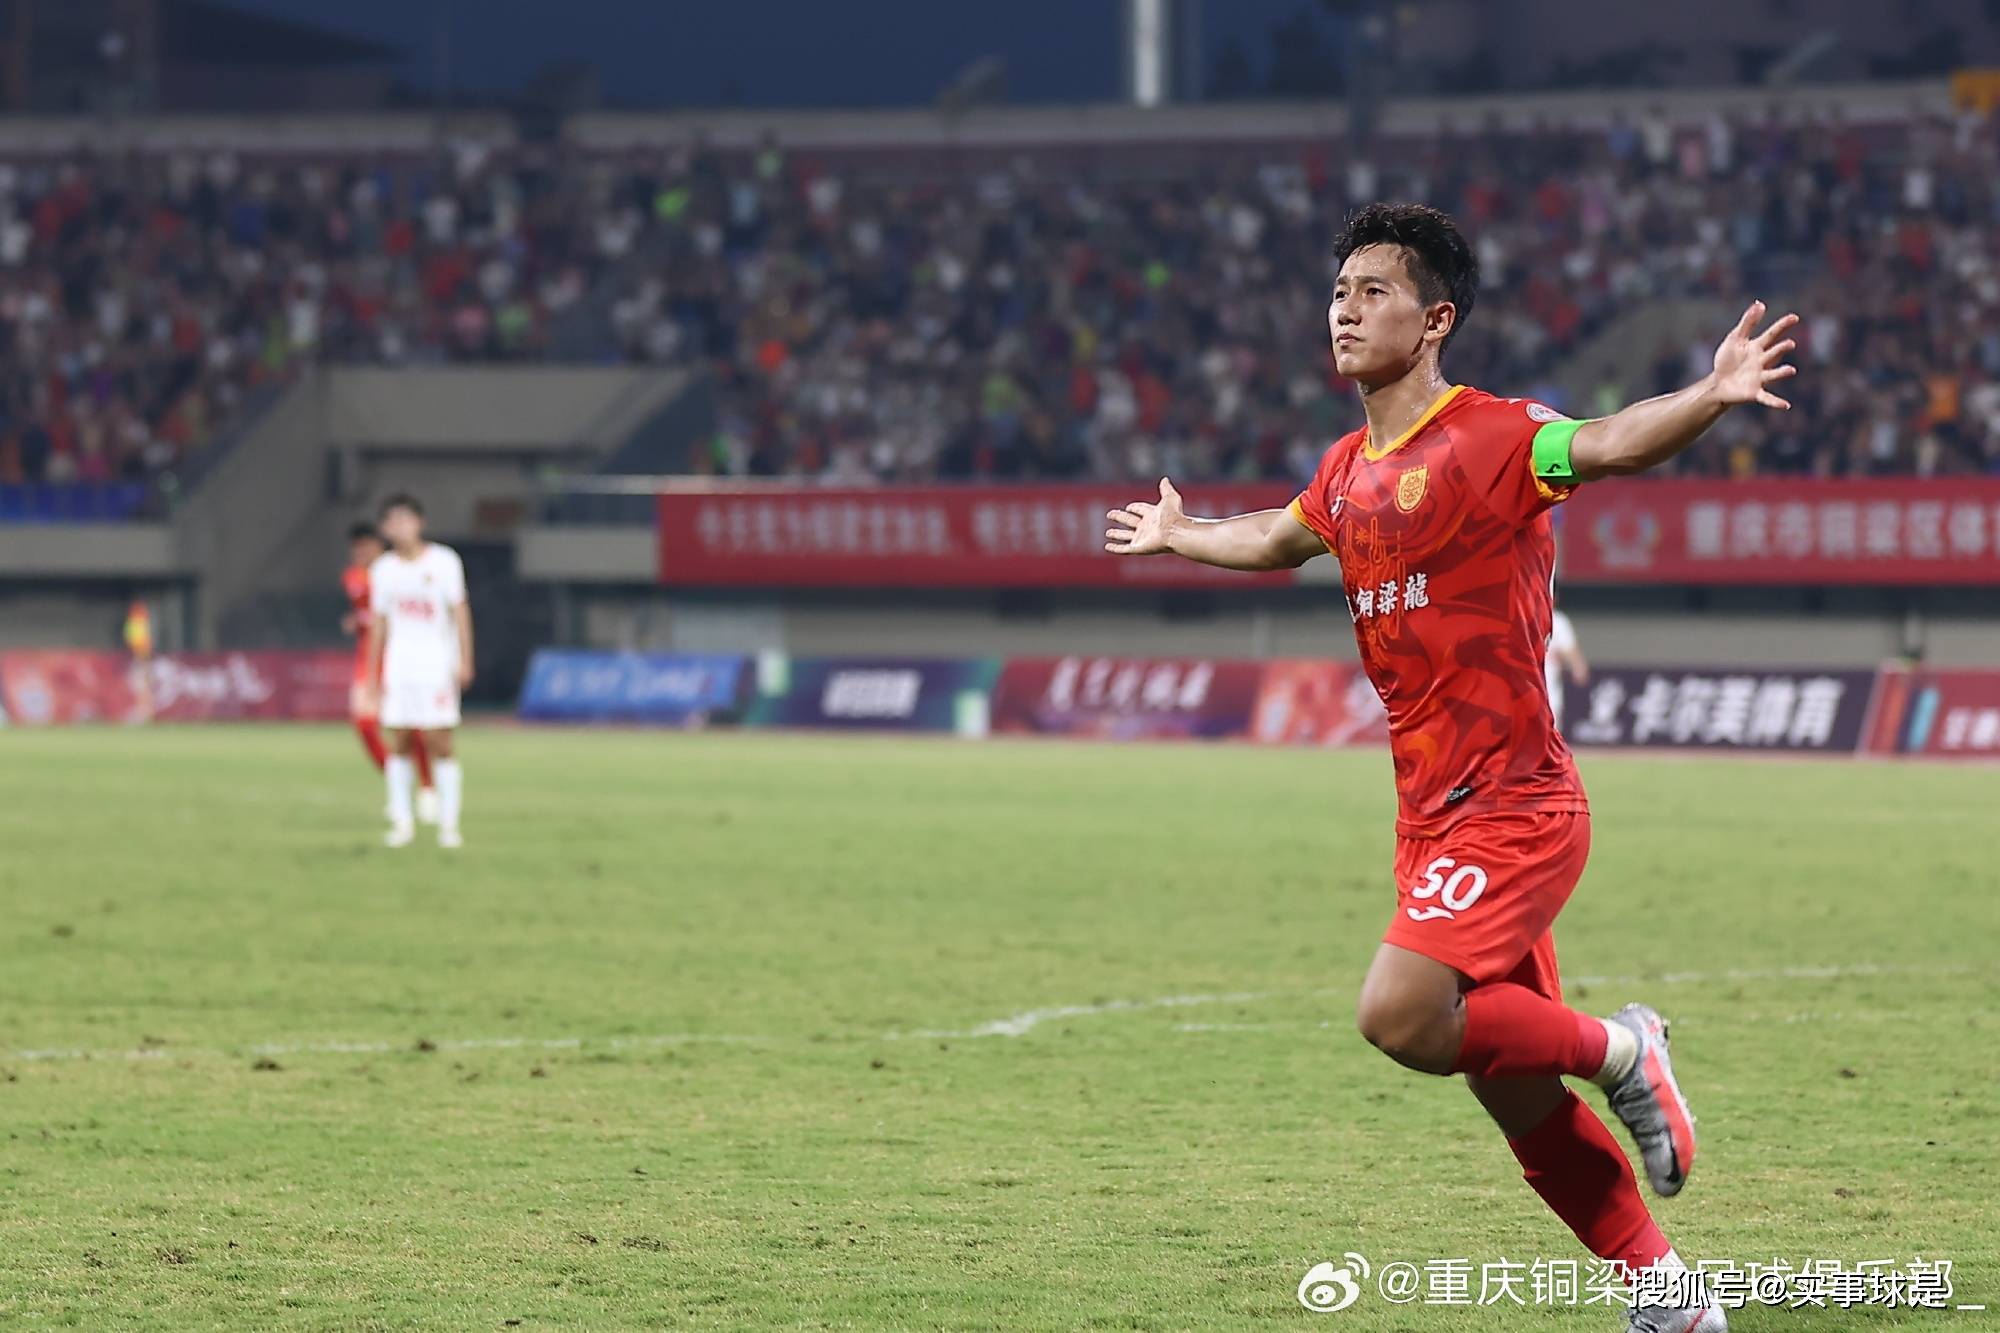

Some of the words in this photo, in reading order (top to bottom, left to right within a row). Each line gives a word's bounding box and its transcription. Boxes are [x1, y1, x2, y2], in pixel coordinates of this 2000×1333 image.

[1686, 502, 2000, 560] 重庆市铜梁区体
[1631, 674, 1845, 746] 卡尔美体育
[1410, 856, 1488, 912] 50
